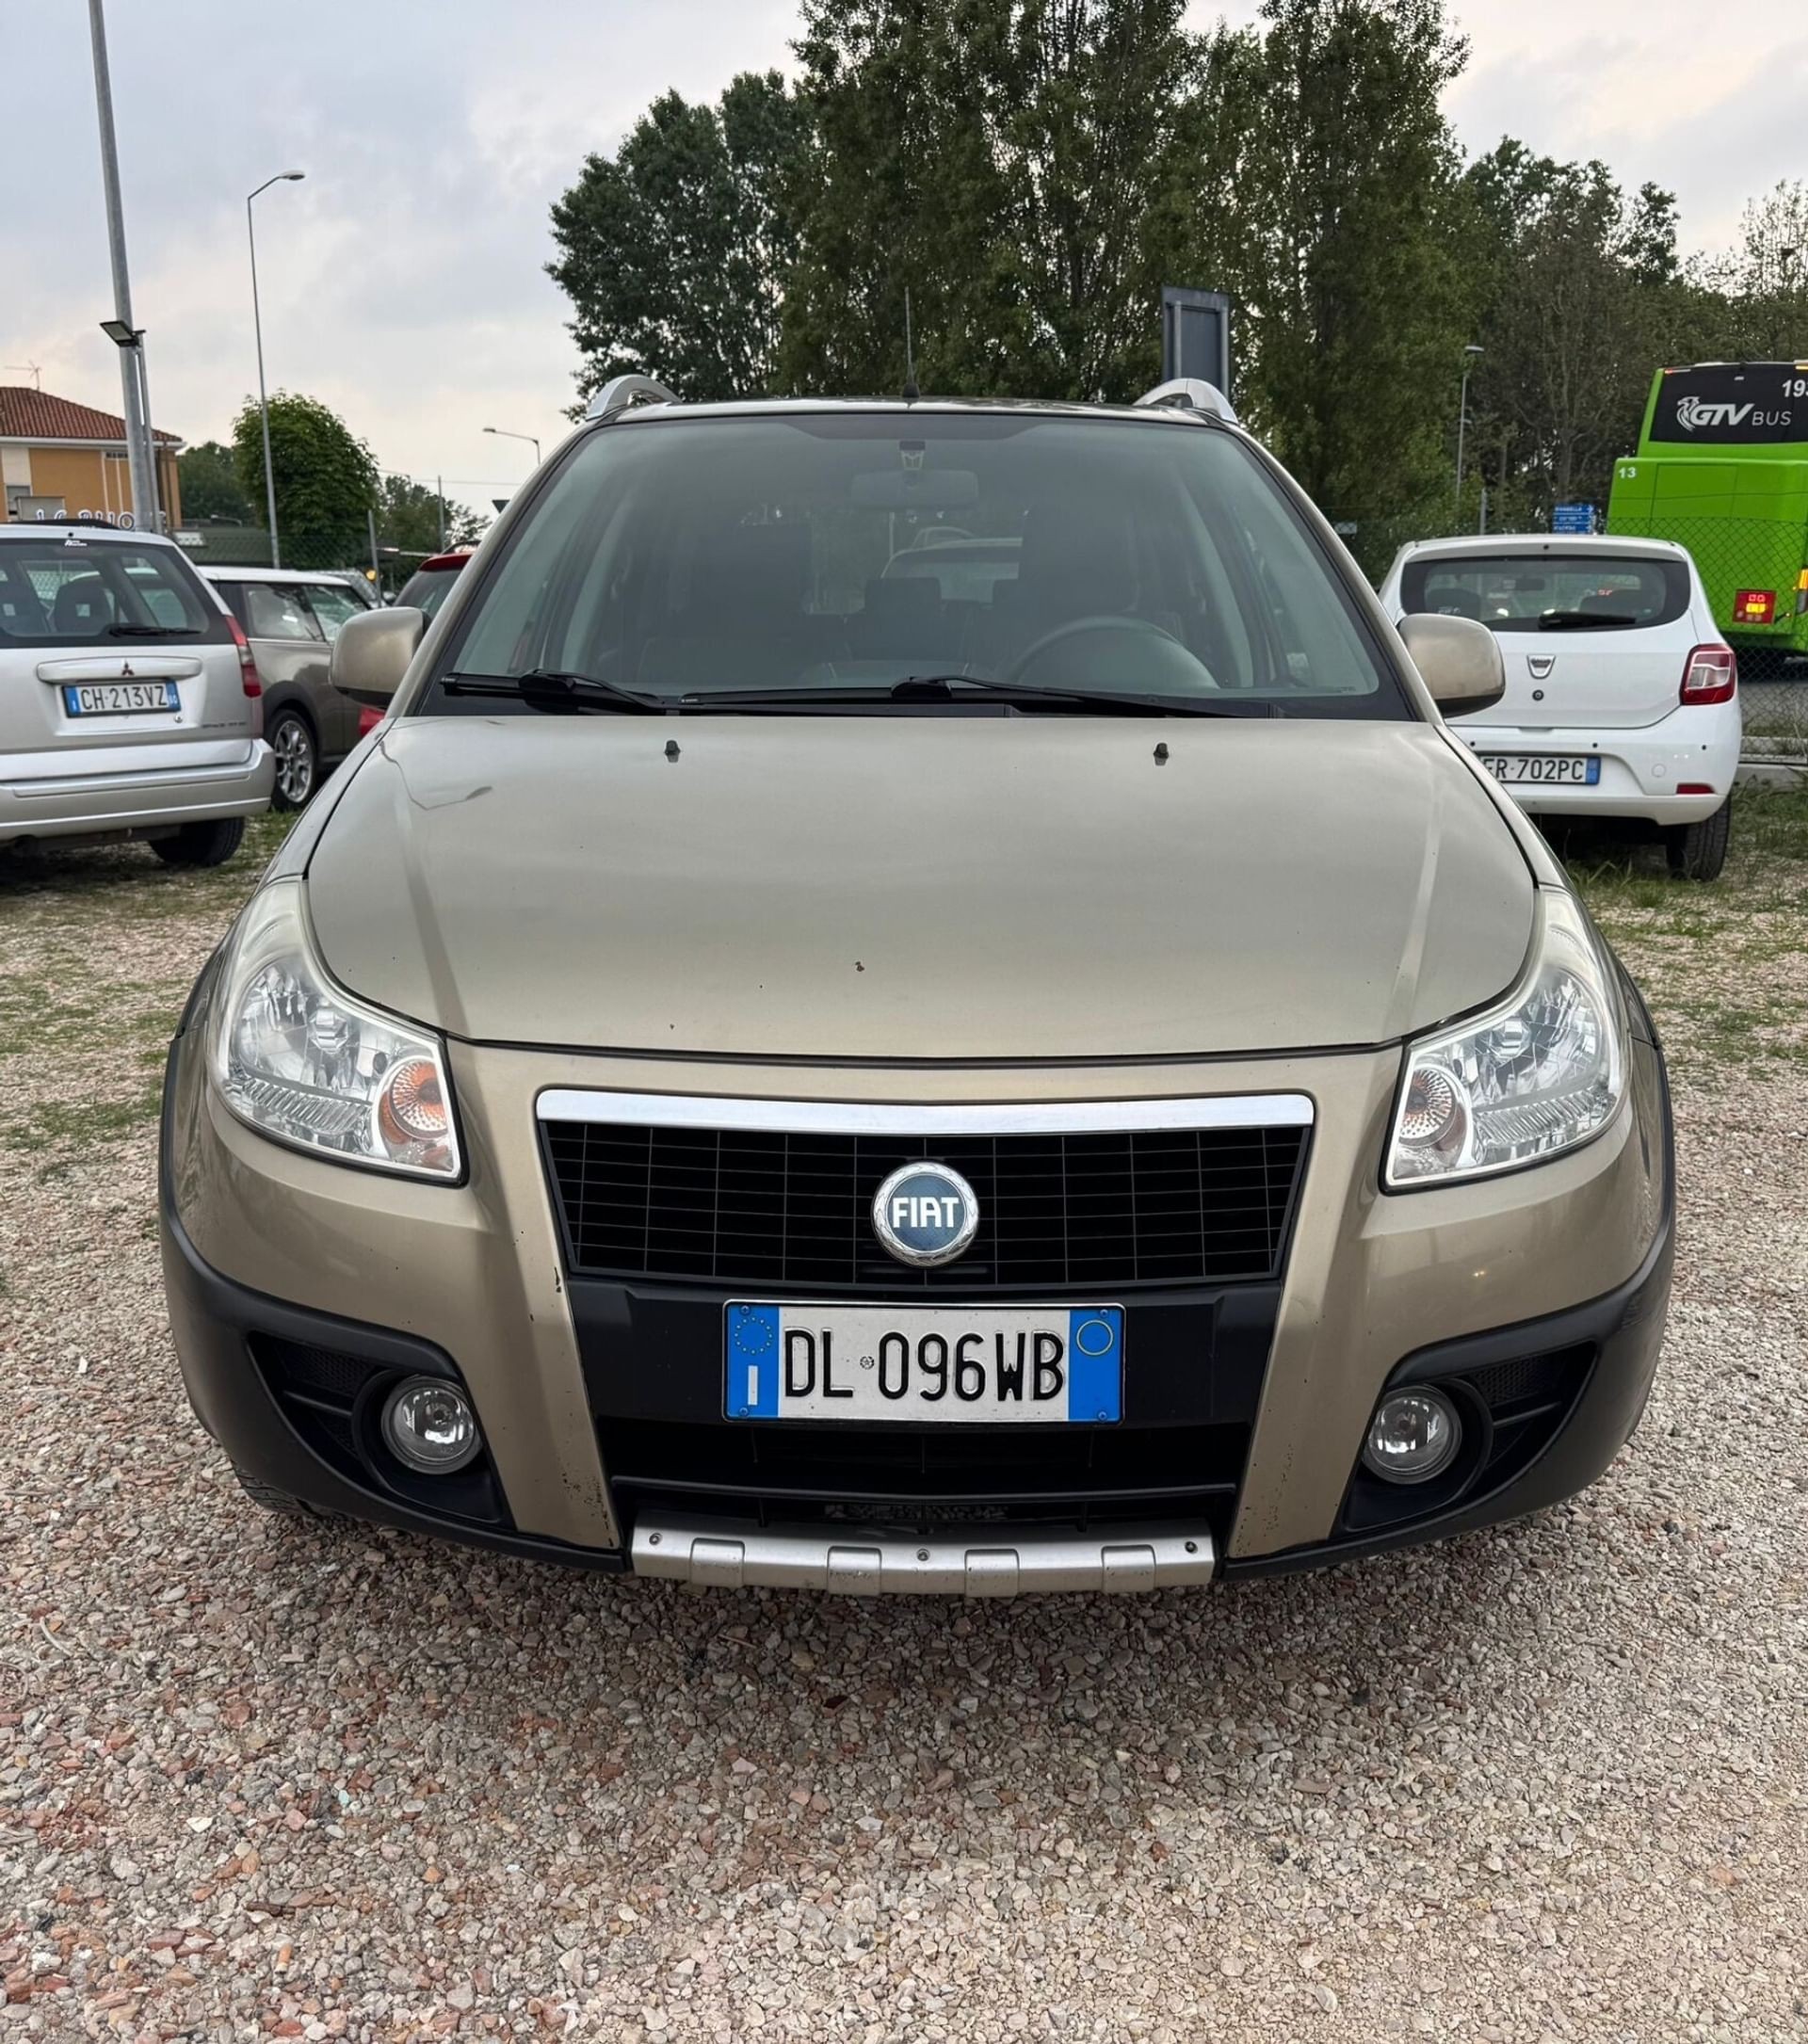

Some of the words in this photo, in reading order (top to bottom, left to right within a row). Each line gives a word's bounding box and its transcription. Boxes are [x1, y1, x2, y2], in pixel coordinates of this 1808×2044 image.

[1782, 379, 1808, 397] 19
[1690, 403, 1754, 427] GTV
[1752, 410, 1792, 427] BUS
[1618, 466, 1637, 479] 13
[80, 687, 105, 710] CH
[109, 685, 168, 709] 213VZ
[1516, 759, 1584, 781] 702PC
[892, 1197, 960, 1228] FIAT
[784, 1328, 854, 1398] DL
[878, 1329, 1065, 1402] 096WB
